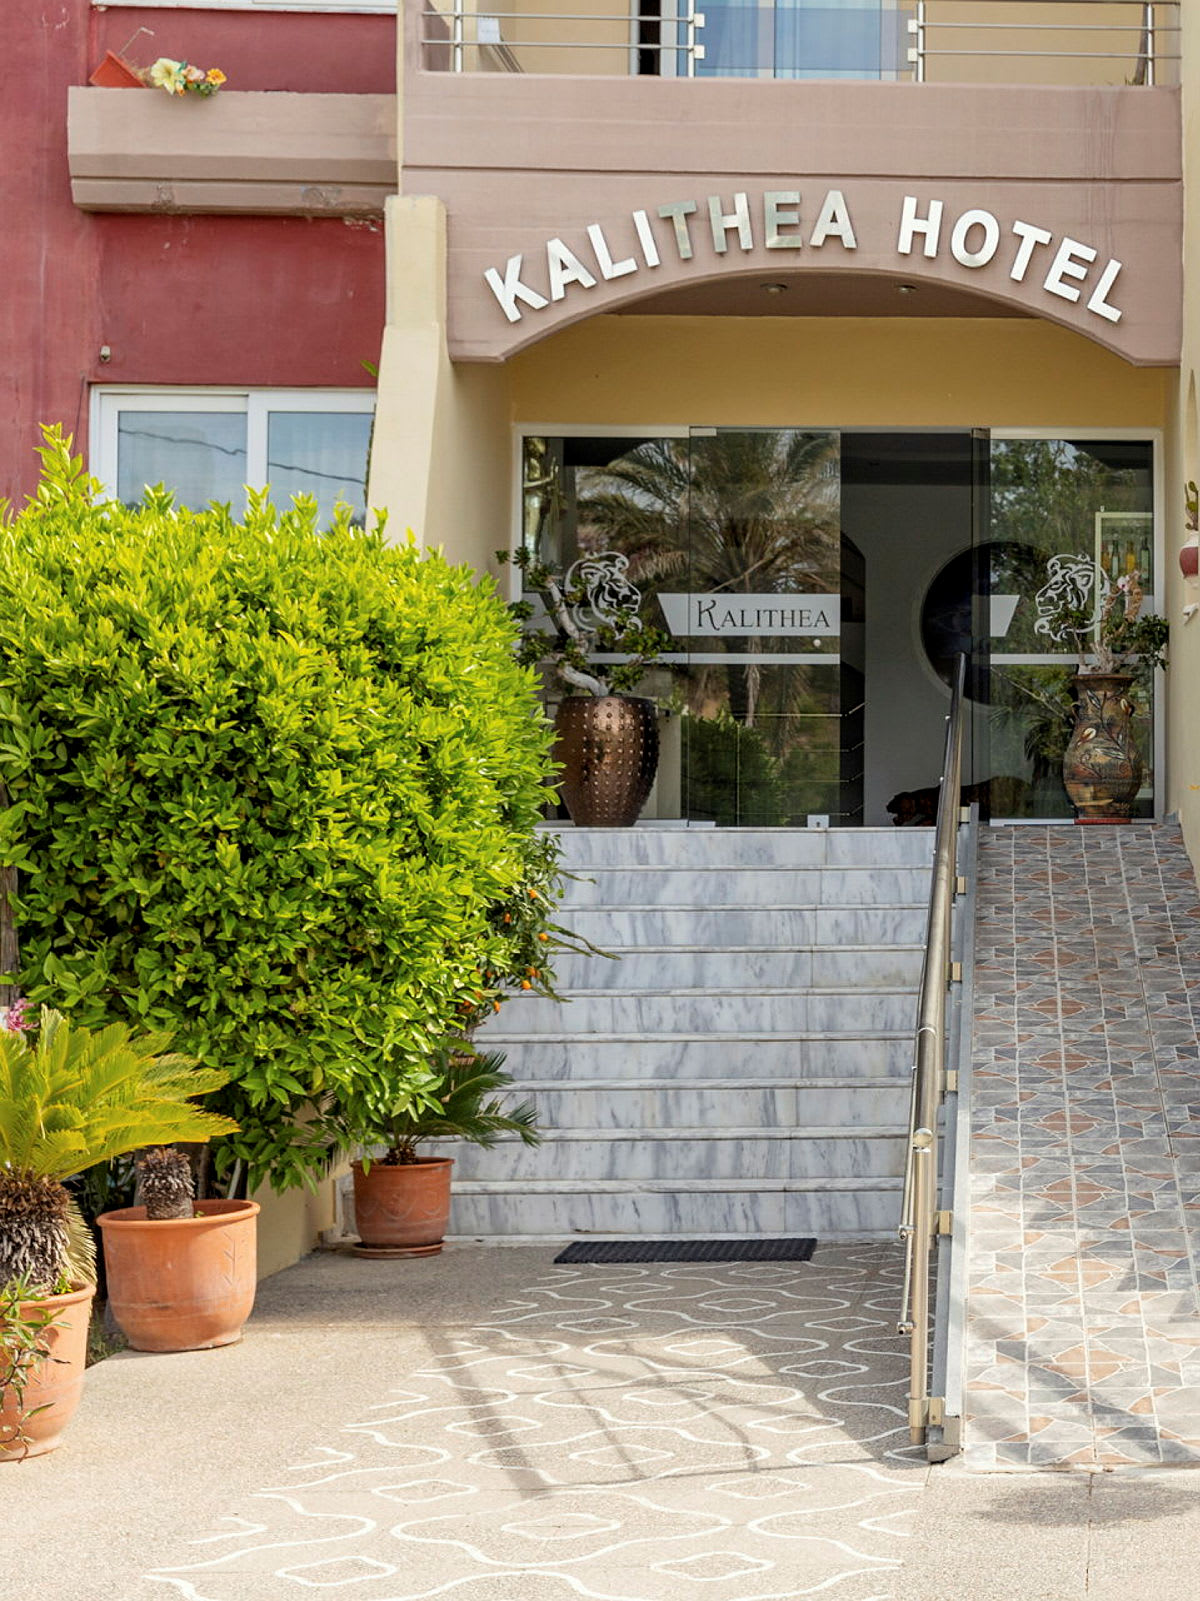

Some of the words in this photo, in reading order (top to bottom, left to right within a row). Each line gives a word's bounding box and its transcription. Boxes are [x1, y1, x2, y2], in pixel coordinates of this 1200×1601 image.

[484, 190, 858, 323] KALITHEA
[898, 196, 1123, 323] HOTEL
[697, 599, 831, 631] KALITHEA
